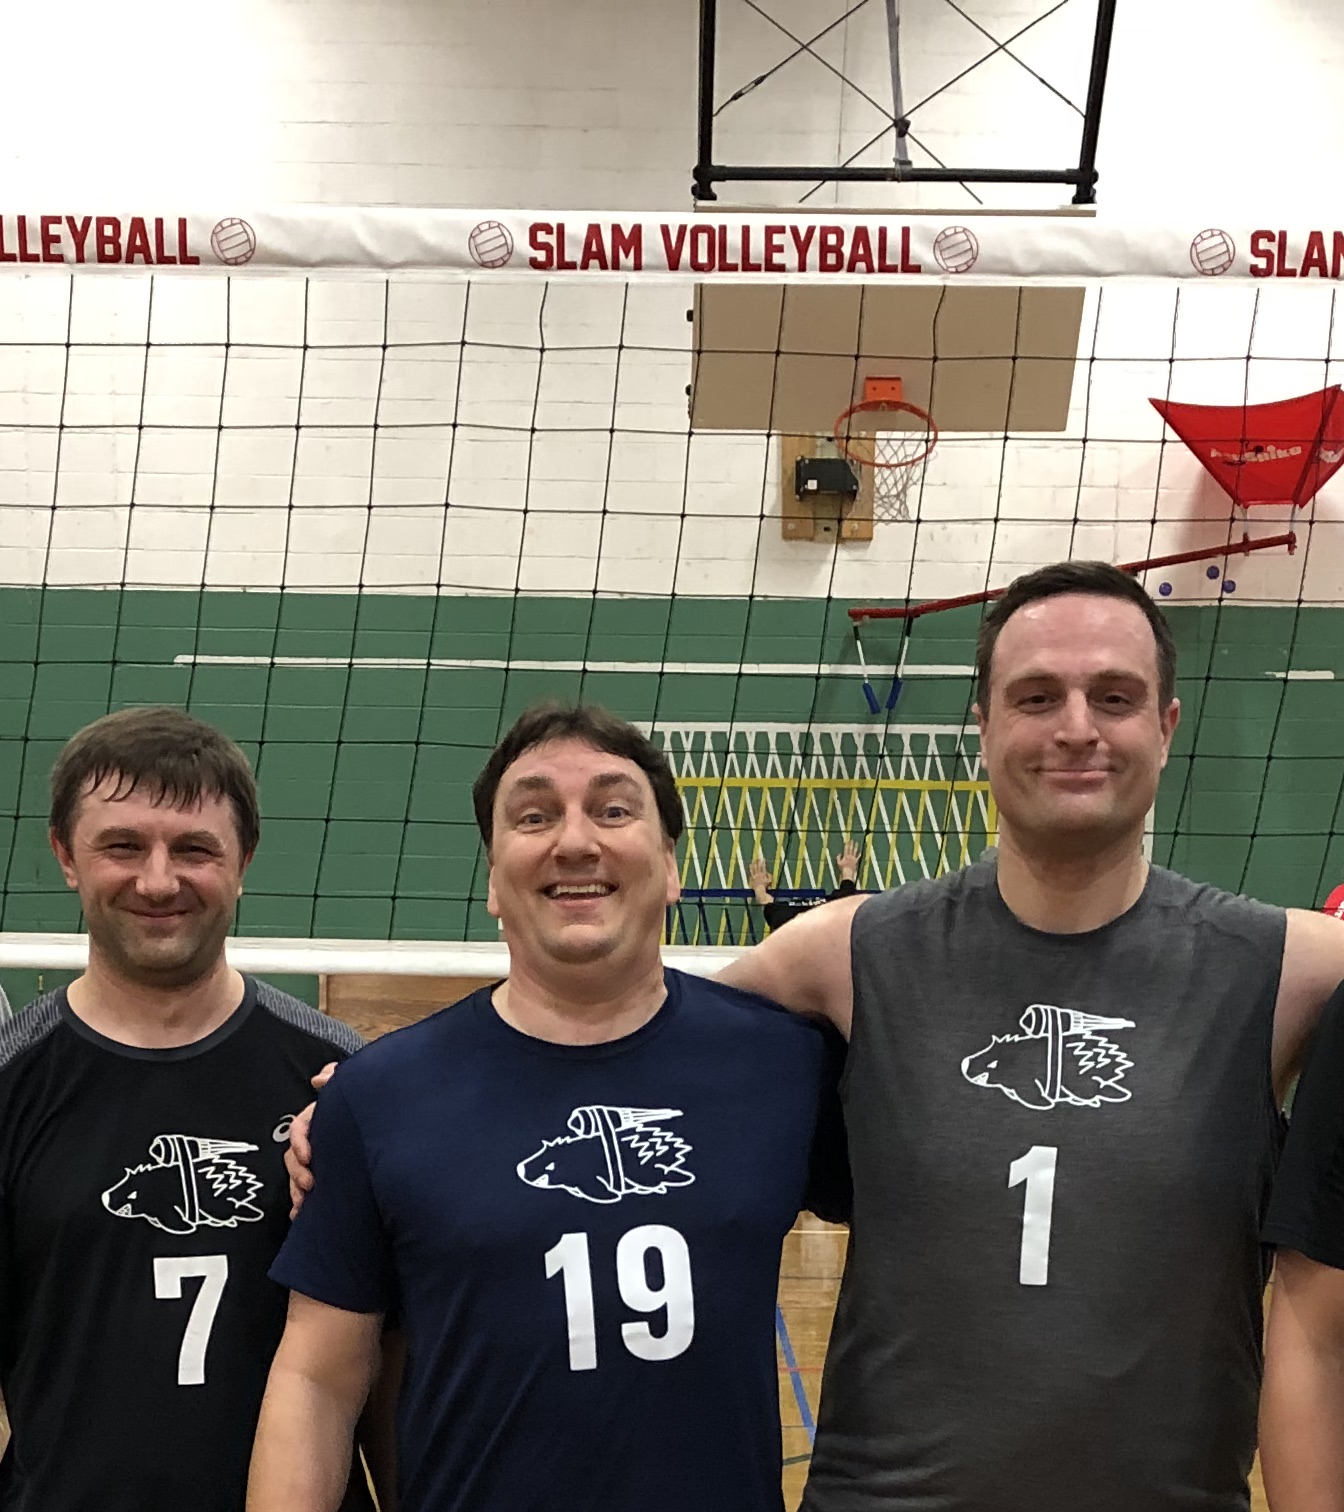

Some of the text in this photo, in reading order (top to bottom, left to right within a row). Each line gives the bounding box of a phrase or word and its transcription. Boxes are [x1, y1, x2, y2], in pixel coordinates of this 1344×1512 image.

[529, 223, 921, 274] SLAM VOLLEYBALL
[1007, 1145, 1058, 1286] 1
[153, 1254, 229, 1386] 7
[544, 1224, 695, 1371] 19
